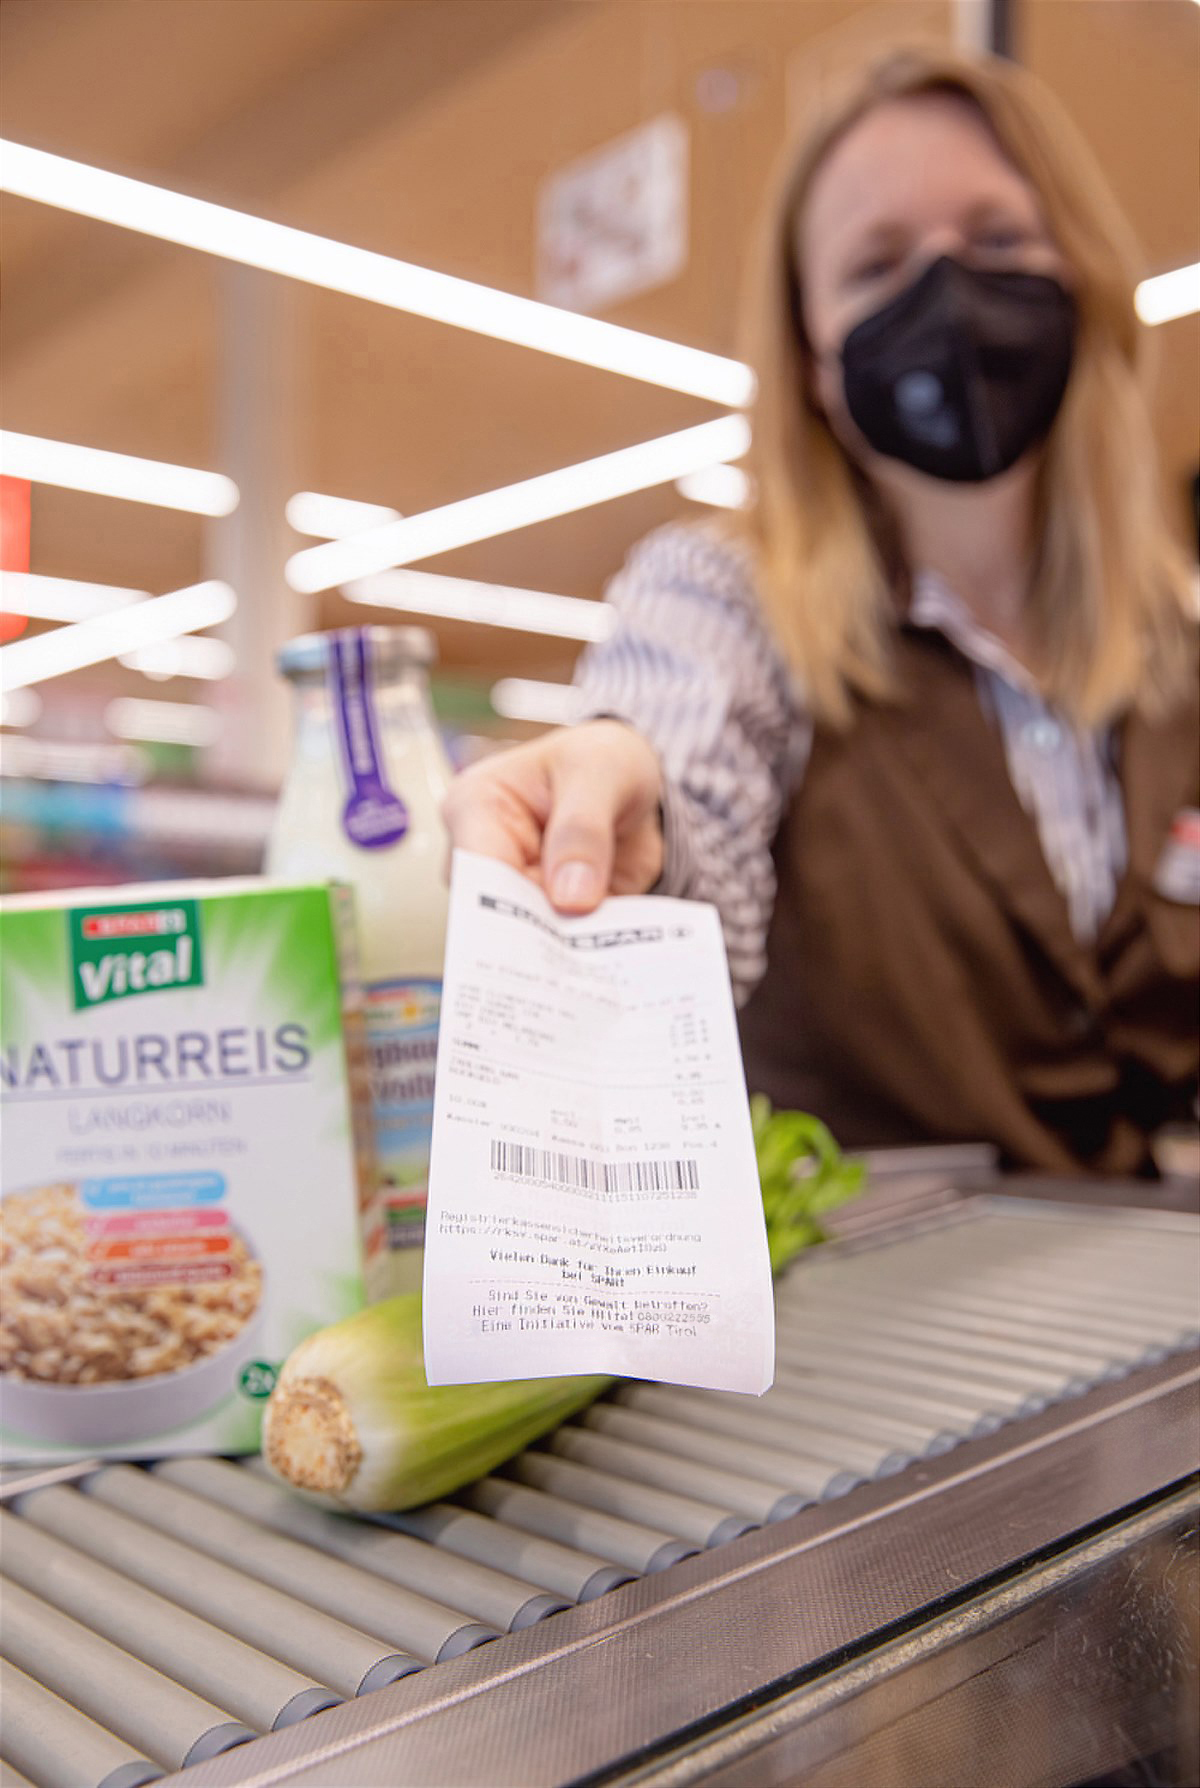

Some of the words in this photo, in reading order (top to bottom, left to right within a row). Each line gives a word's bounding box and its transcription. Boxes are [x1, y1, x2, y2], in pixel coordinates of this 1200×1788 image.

[78, 934, 193, 1001] Vital
[67, 1099, 232, 1132] LANGKORN
[489, 1248, 535, 1263] Vielen
[540, 1253, 570, 1268] Dank
[605, 1265, 641, 1276] Ihren
[646, 1264, 696, 1275] Einkauf
[561, 1268, 582, 1281] bei
[488, 1289, 519, 1301] Sind
[525, 1289, 548, 1302] Sie
[555, 1295, 578, 1304] von
[584, 1295, 629, 1309] Gewalt
[472, 1304, 503, 1316] Hier
[511, 1303, 556, 1316] finden
[563, 1304, 585, 1316] Sie
[481, 1318, 512, 1332] Eine
[519, 1317, 595, 1331] Initiative
[666, 1324, 697, 1337] Tirol
